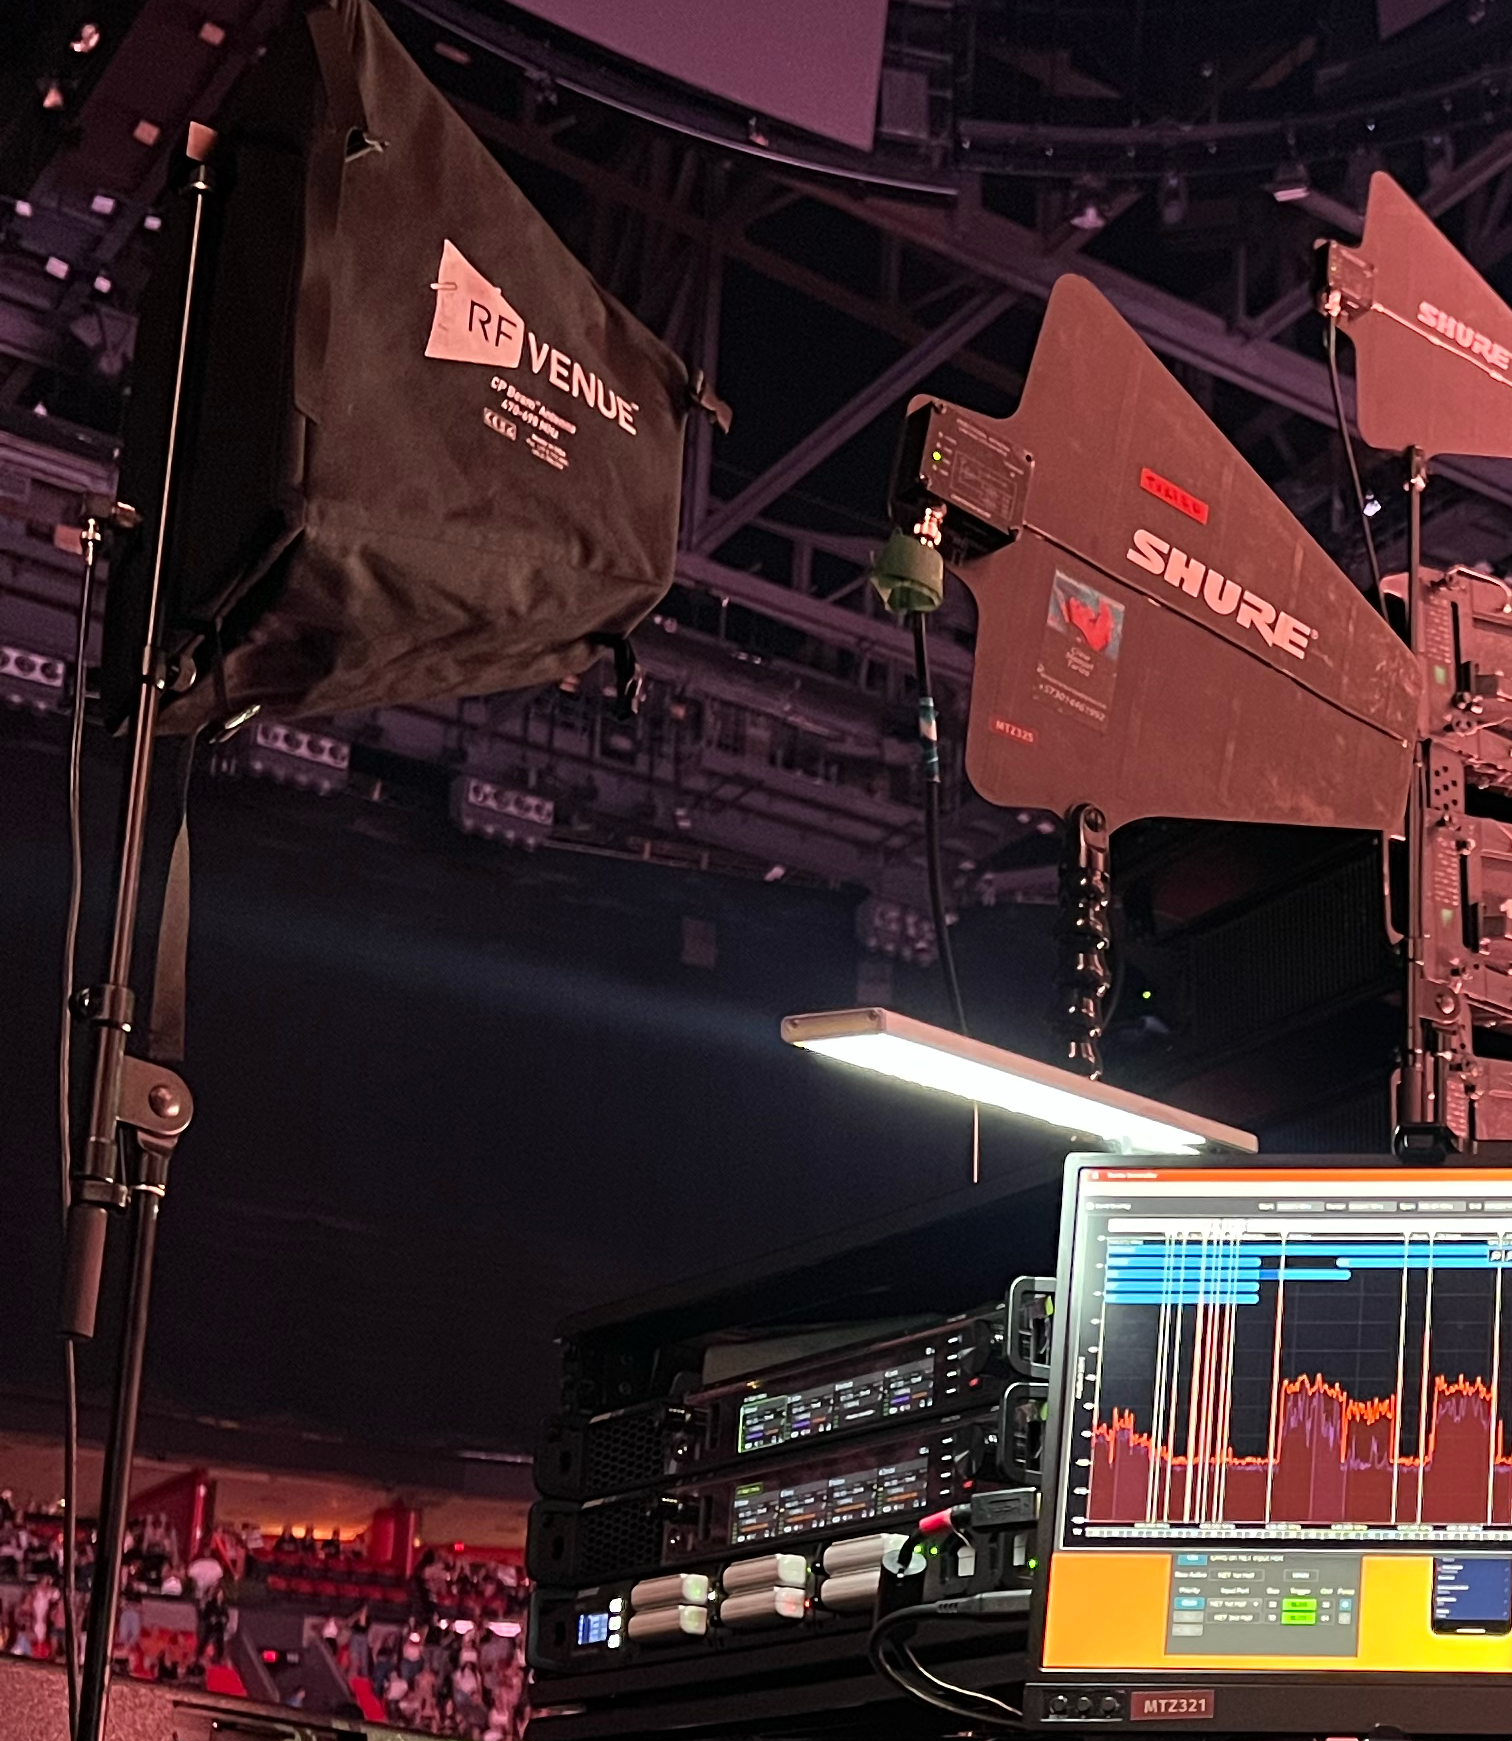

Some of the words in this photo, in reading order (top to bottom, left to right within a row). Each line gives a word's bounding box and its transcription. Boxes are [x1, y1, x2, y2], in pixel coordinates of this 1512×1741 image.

[468, 299, 517, 347] RF
[527, 331, 637, 436] VENUE
[1126, 528, 1312, 660] SHURE
[1144, 1696, 1208, 1716] MTZ321
